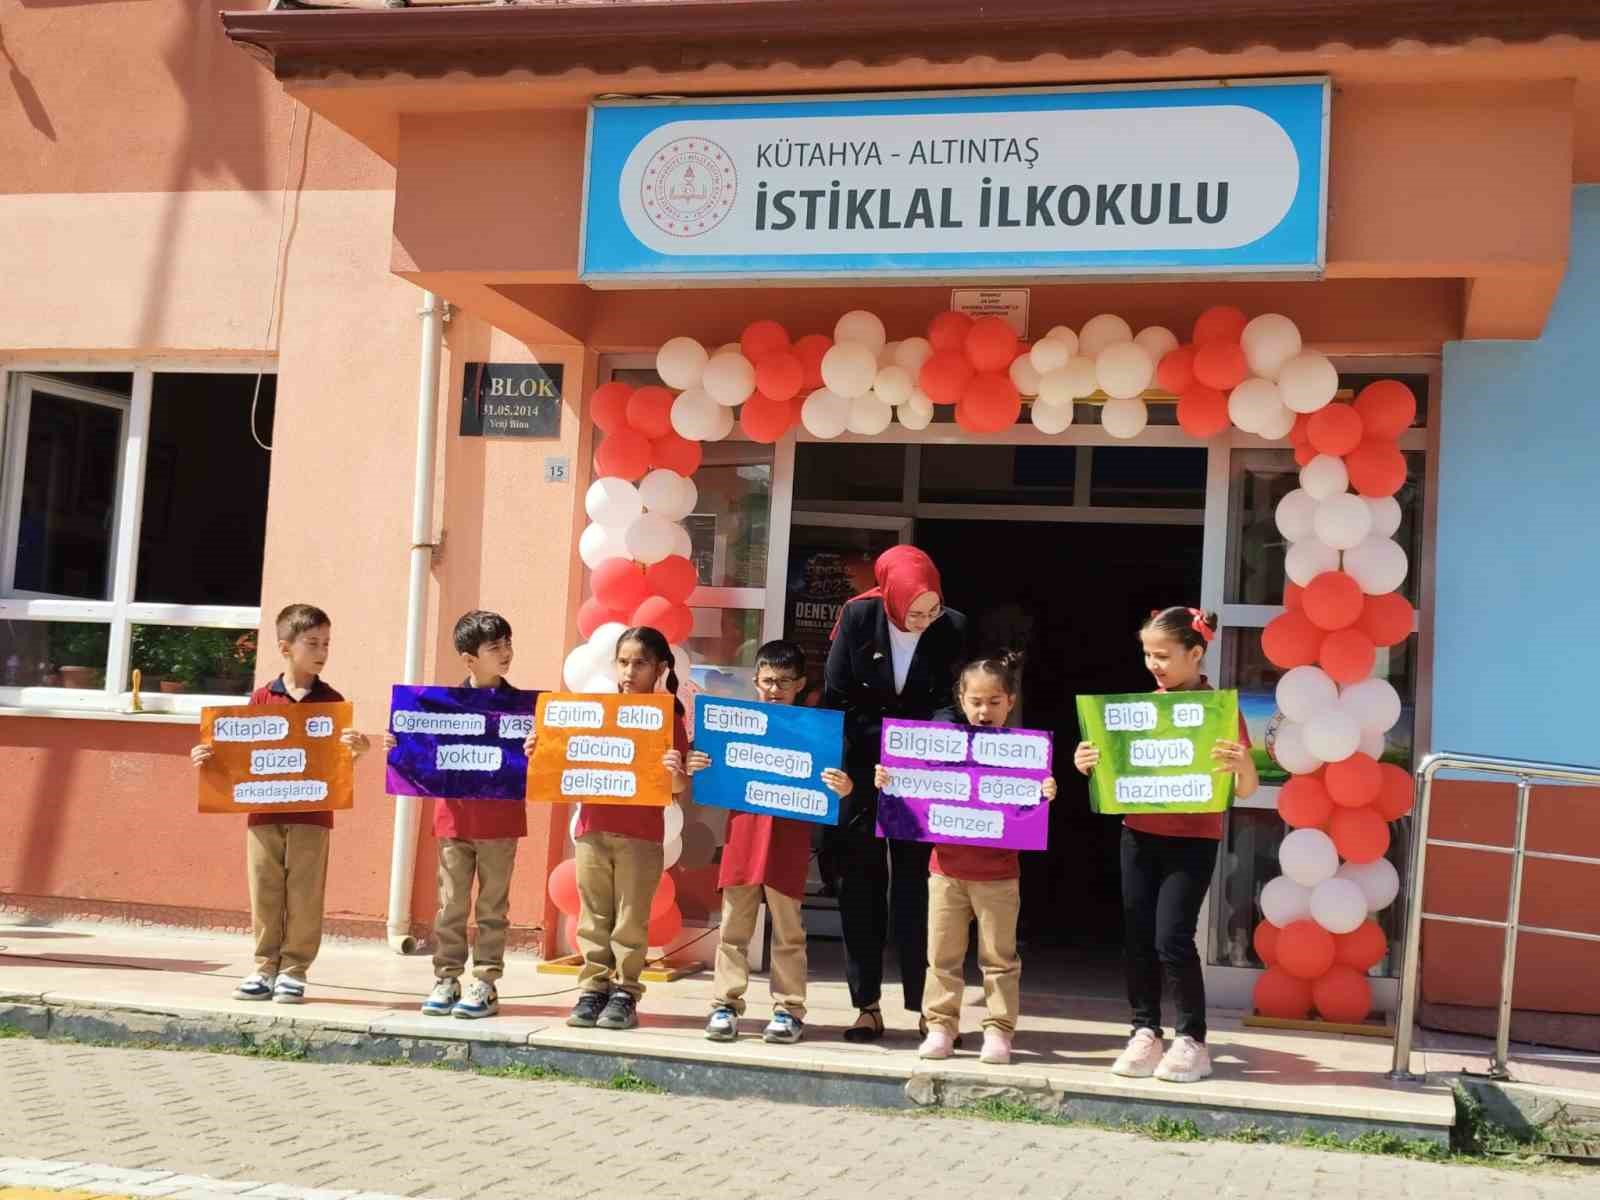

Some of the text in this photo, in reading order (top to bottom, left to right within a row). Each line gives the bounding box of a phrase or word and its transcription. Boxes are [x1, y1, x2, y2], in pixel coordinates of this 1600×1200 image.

[756, 138, 883, 168] KÜTAHYA
[908, 137, 1040, 169] ALTINTAŞ
[755, 180, 963, 231] İSTİKLAL
[979, 177, 1229, 228] İLKOKULU
[490, 377, 555, 397] BLOK
[550, 465, 564, 477] 15
[619, 706, 660, 725] aklın
[706, 706, 764, 732] Eğitim,
[1177, 708, 1200, 722] en
[216, 719, 331, 739] Kitaplar en
[568, 740, 632, 760] gücünü
[889, 731, 962, 755] Bilgisiz
[1132, 742, 1190, 764] büyük
[254, 751, 303, 772] güzel
[439, 748, 499, 767] yoktur.
[728, 745, 810, 773] geleceğin
[888, 774, 1038, 799] meyvesiz ağaca
[1118, 779, 1211, 799] hazinedir.
[749, 786, 826, 813] temelidir.
[932, 810, 999, 834] benzer.
